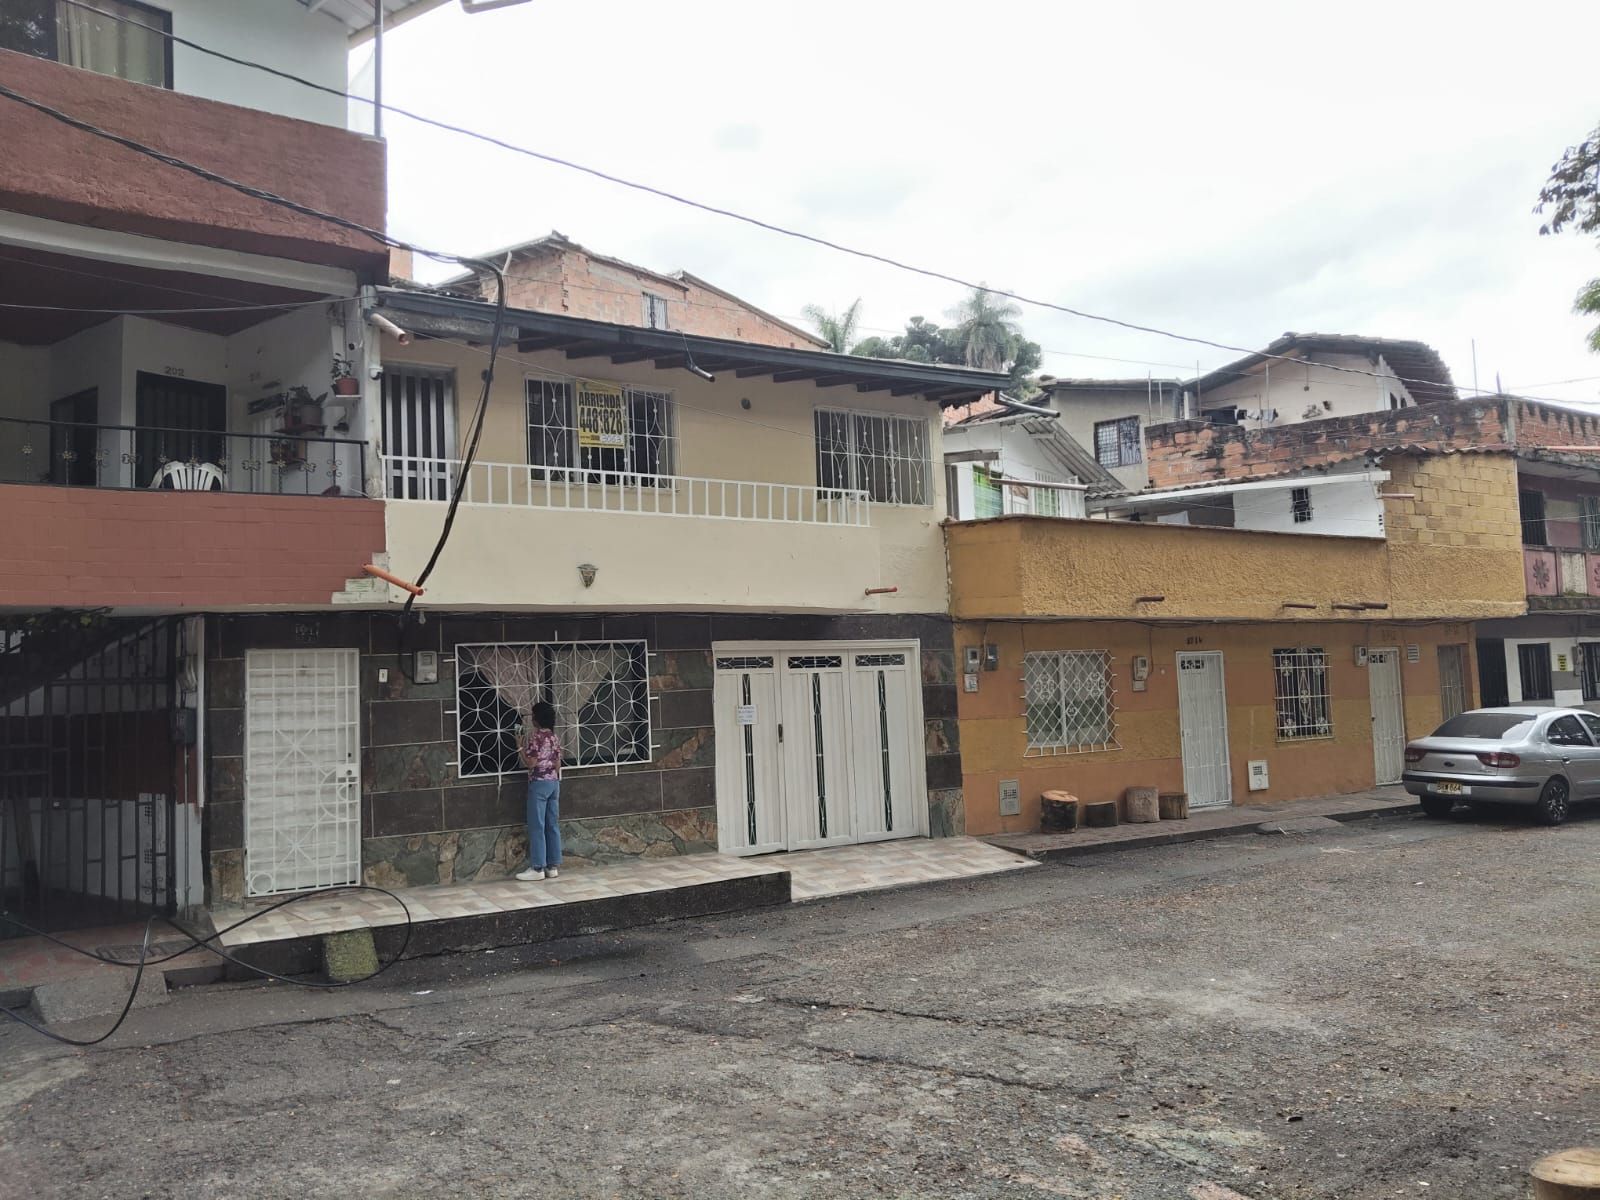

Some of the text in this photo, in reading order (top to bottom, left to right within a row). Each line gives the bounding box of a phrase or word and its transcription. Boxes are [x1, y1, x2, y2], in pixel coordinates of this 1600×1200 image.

[164, 366, 185, 377] 202
[579, 391, 621, 408] ARRIENDA
[579, 407, 623, 435] 4481828
